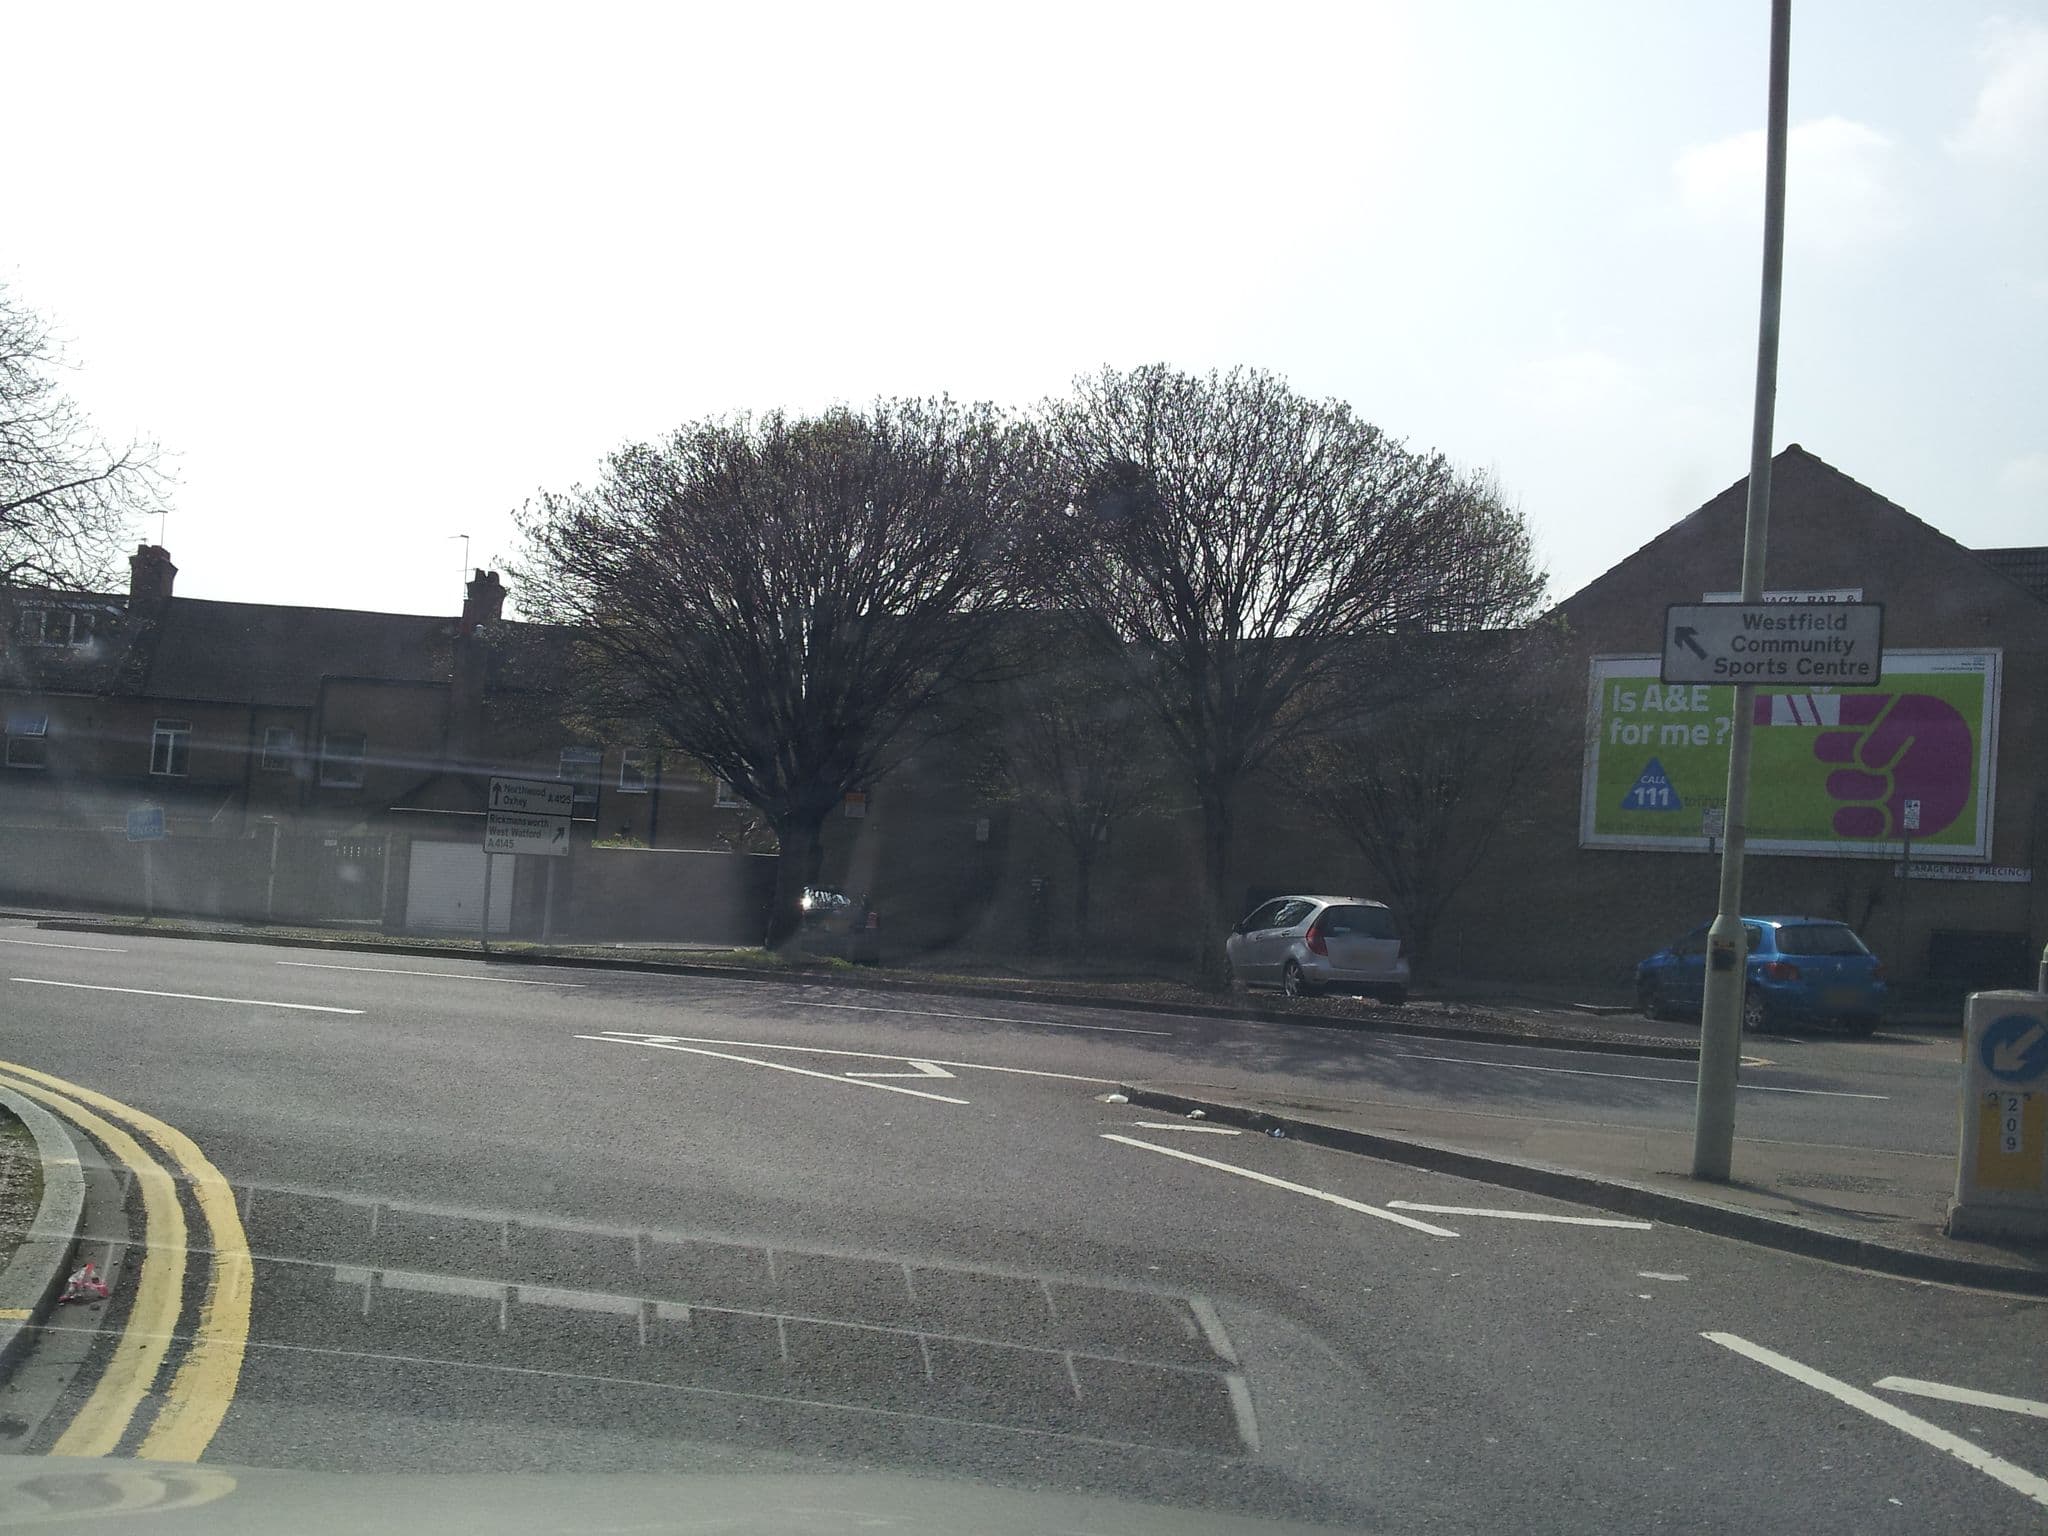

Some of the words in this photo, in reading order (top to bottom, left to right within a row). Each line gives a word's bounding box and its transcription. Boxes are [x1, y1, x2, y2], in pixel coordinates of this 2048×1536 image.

[1743, 613, 1847, 631] Westfield
[1731, 636, 1855, 655] Community
[1714, 658, 1787, 676] Sports
[1796, 658, 1869, 676] Centre
[1613, 685, 1637, 712] Is
[1641, 684, 1711, 712] A&E
[1610, 717, 1654, 745] for
[1660, 717, 1731, 746] me?
[1641, 775, 1667, 784] CALL
[503, 784, 545, 797] Northwood
[1634, 787, 1670, 806] 111
[489, 814, 551, 828] Rickmansworth
[489, 826, 508, 837] West
[511, 828, 541, 838] Watford
[488, 838, 514, 848] A4145
[1948, 865, 1975, 874] ROAD
[1978, 866, 2027, 877] PRECINCT
